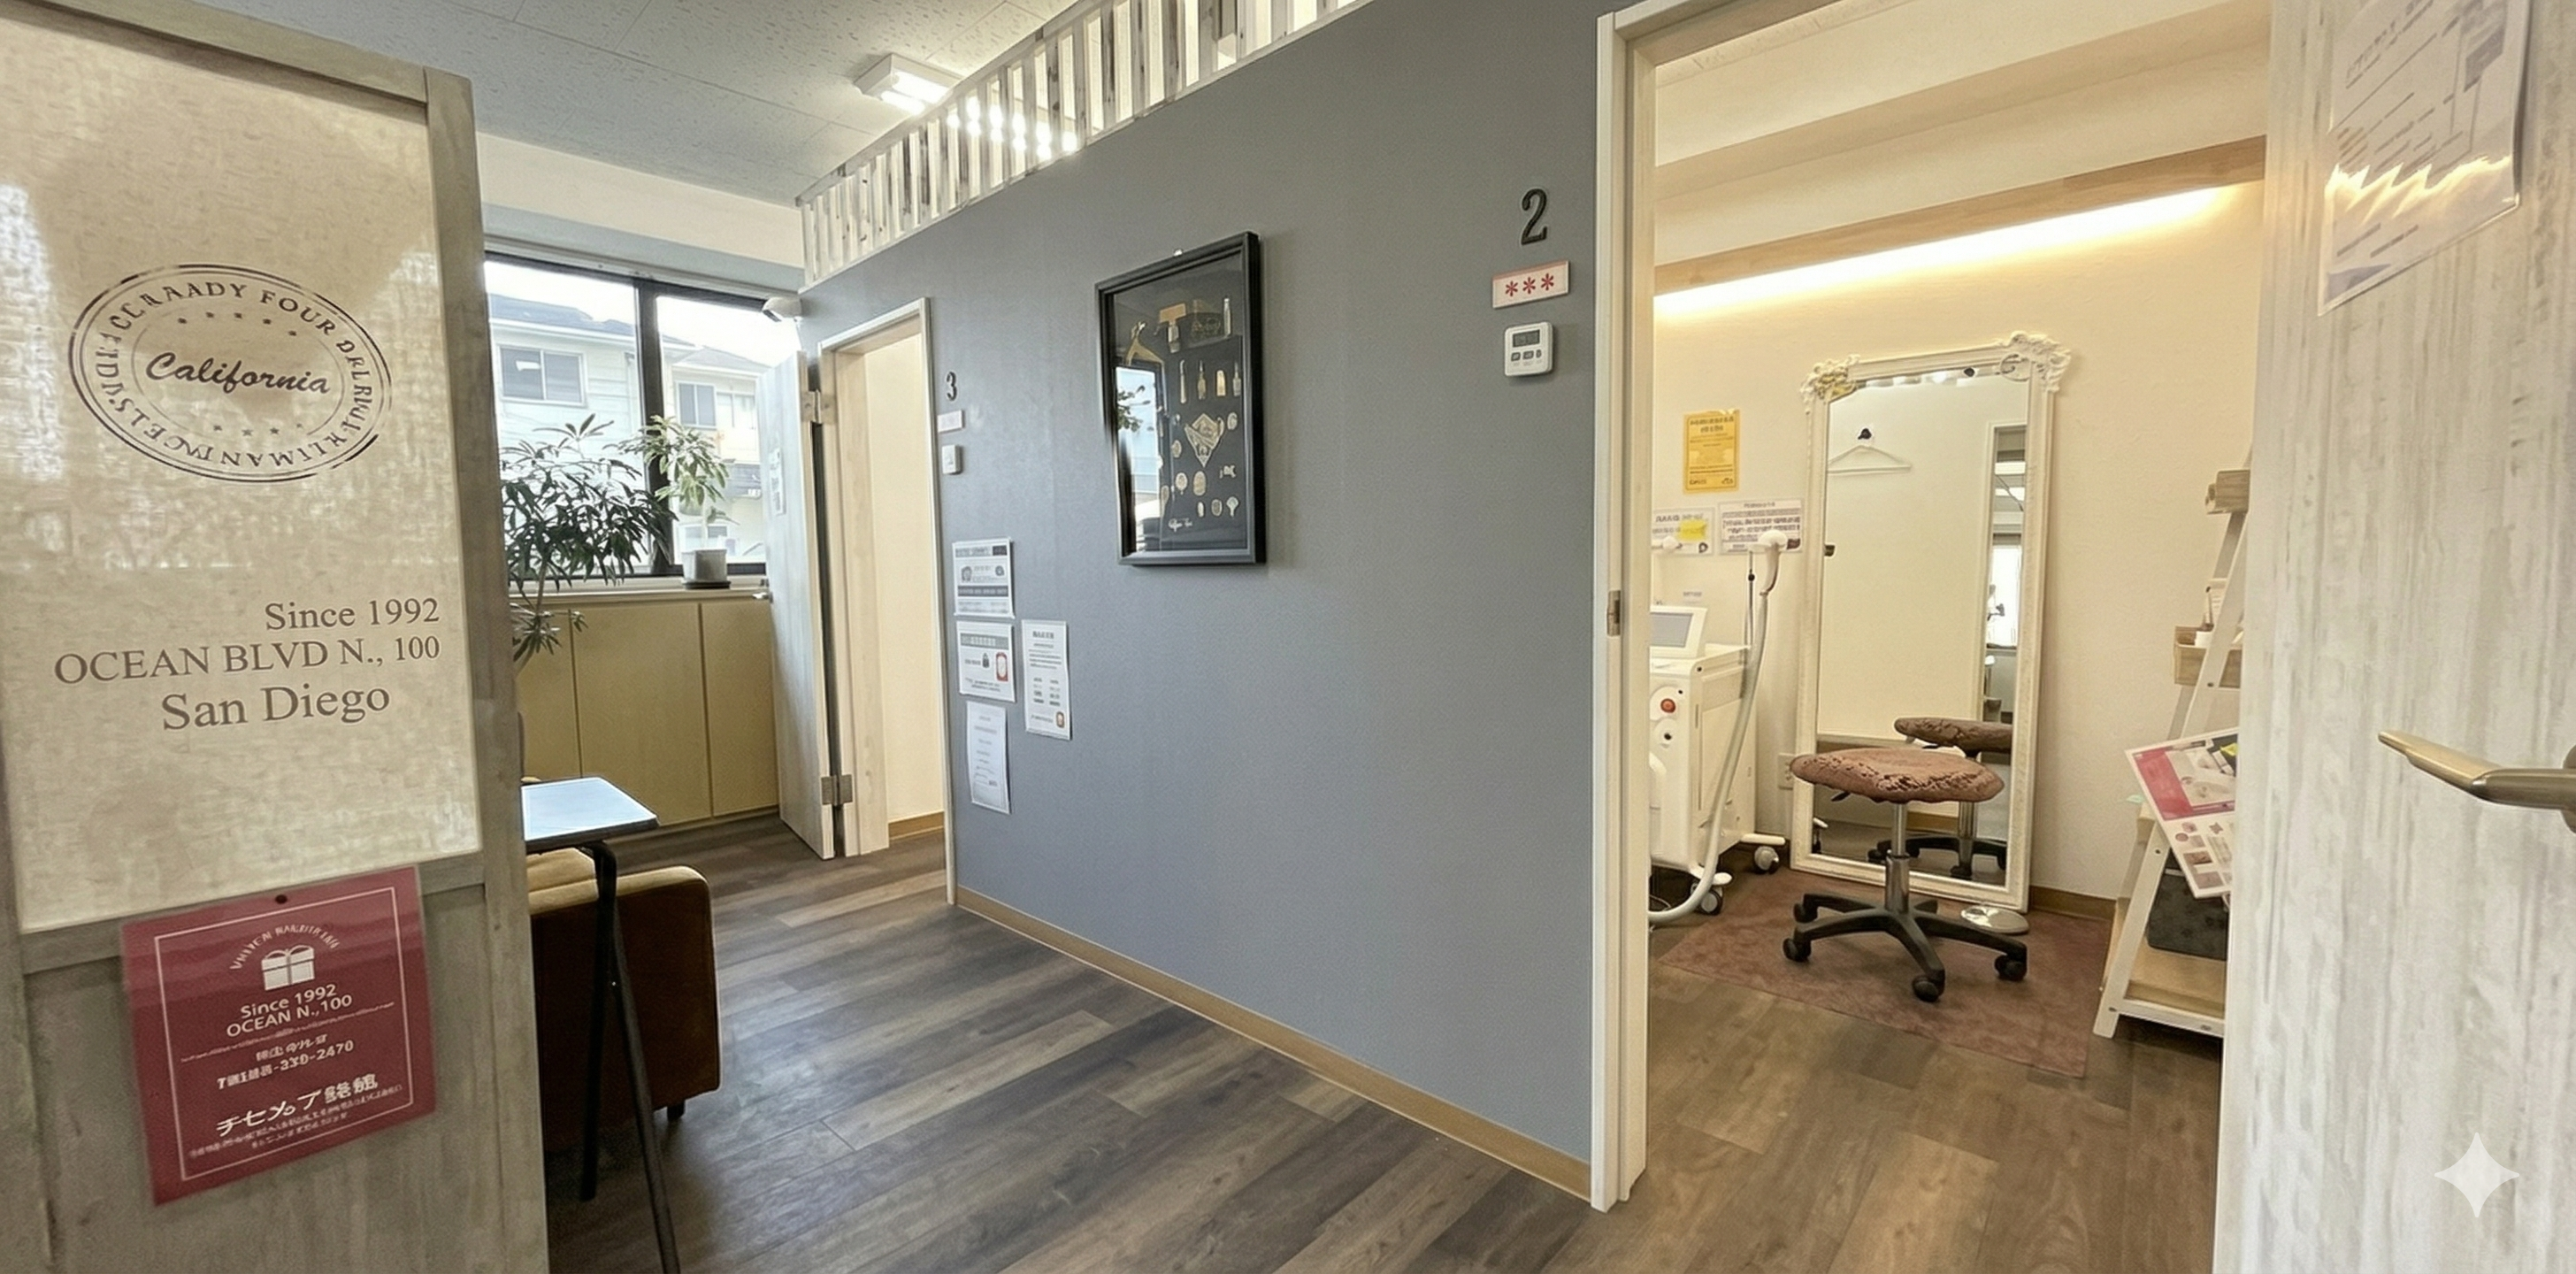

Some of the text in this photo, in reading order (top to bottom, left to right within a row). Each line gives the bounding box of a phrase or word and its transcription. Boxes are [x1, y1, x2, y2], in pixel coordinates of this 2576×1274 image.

[1521, 188, 1548, 245] 2
[260, 288, 338, 337] FOUR
[144, 350, 332, 395] California
[946, 371, 957, 402] 3
[264, 596, 441, 632] Since 1992
[54, 635, 441, 685] OCEAN BLVD N., 100
[161, 683, 391, 732] San Diego
[226, 1011, 292, 1037] OCEAN
[241, 984, 338, 1019] Since 1992
